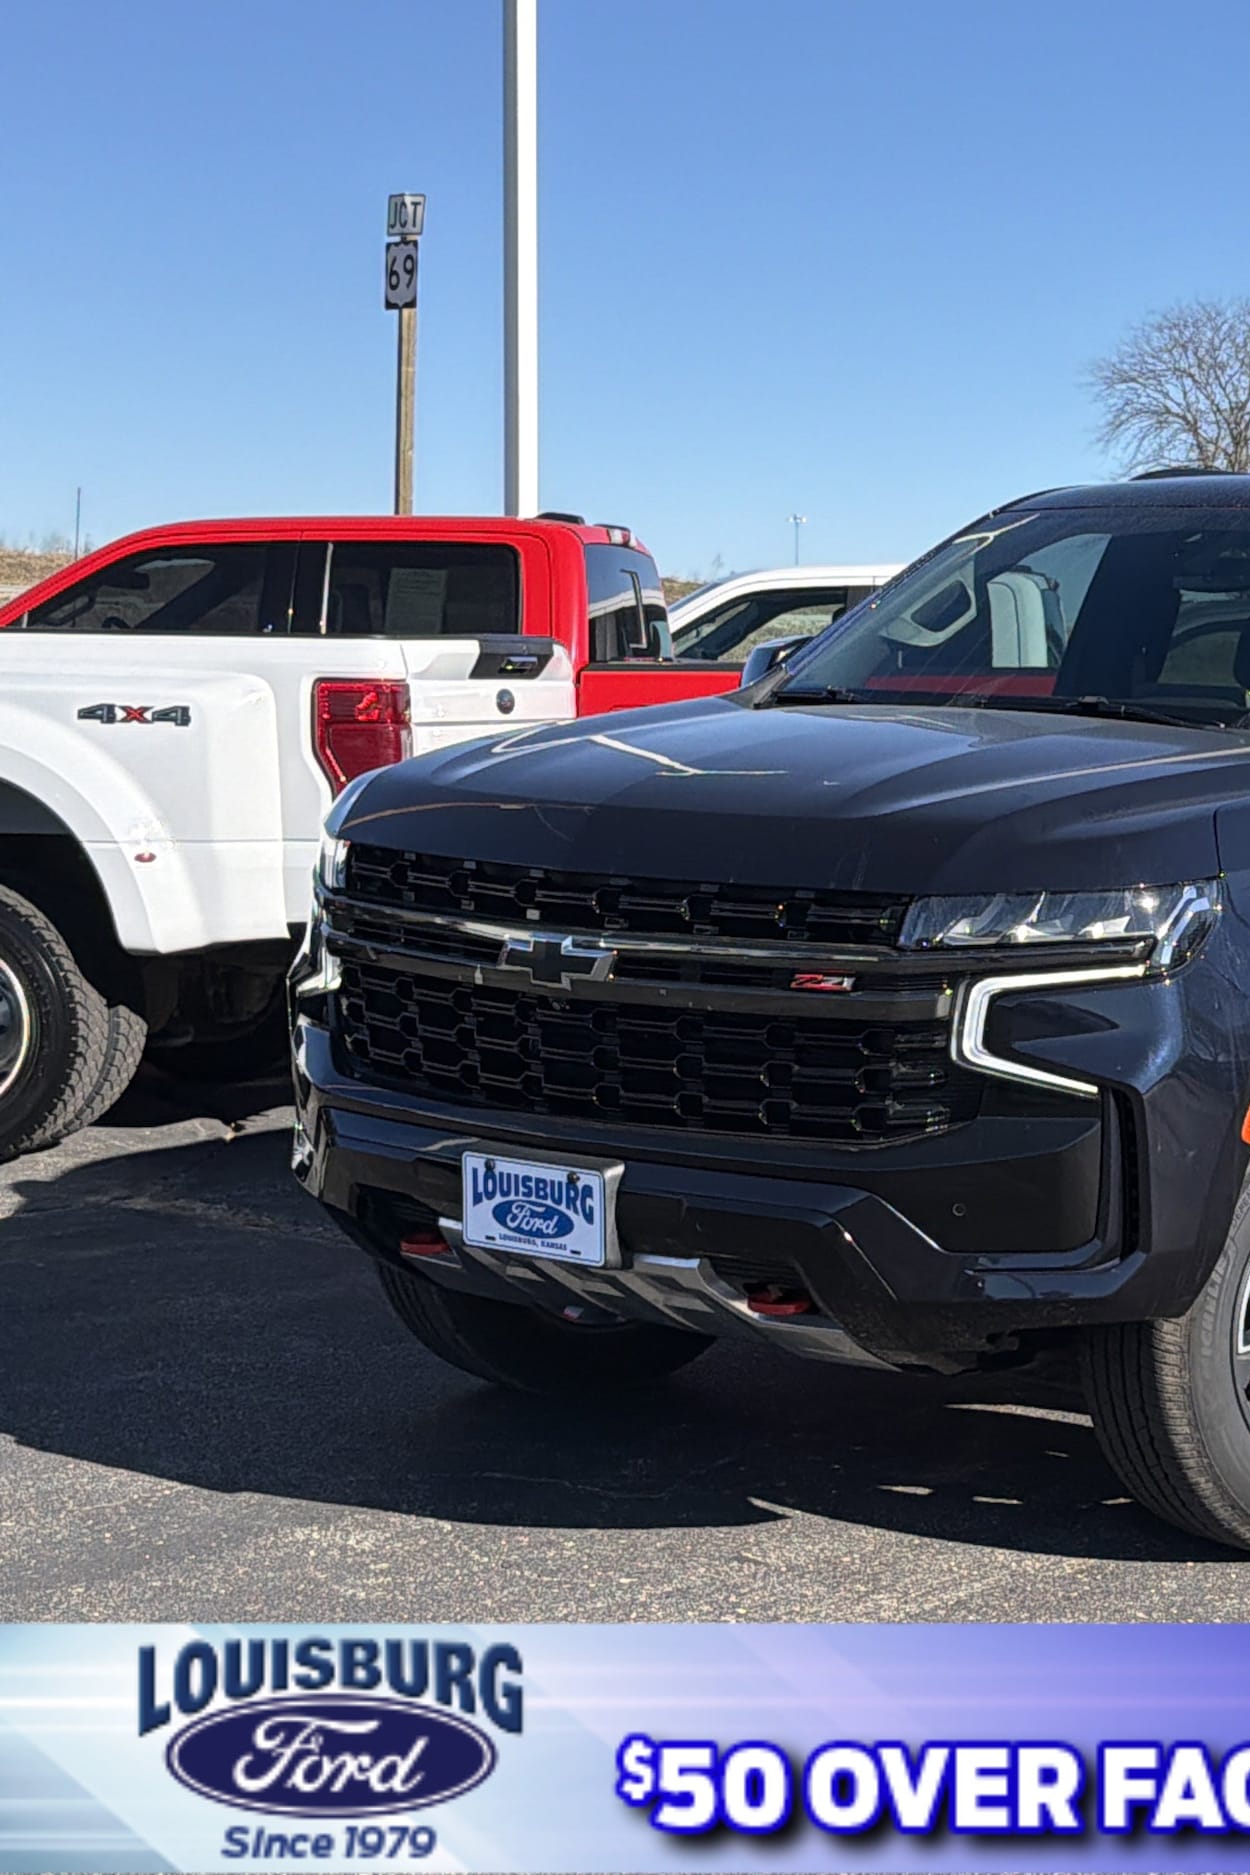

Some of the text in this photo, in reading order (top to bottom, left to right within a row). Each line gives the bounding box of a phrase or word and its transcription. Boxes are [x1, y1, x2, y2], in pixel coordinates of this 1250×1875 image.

[389, 201, 421, 229] JCT
[388, 254, 414, 291] 69
[790, 973, 856, 991] Z71
[472, 1167, 594, 1225] LOUISBURG
[506, 1201, 558, 1235] Ford
